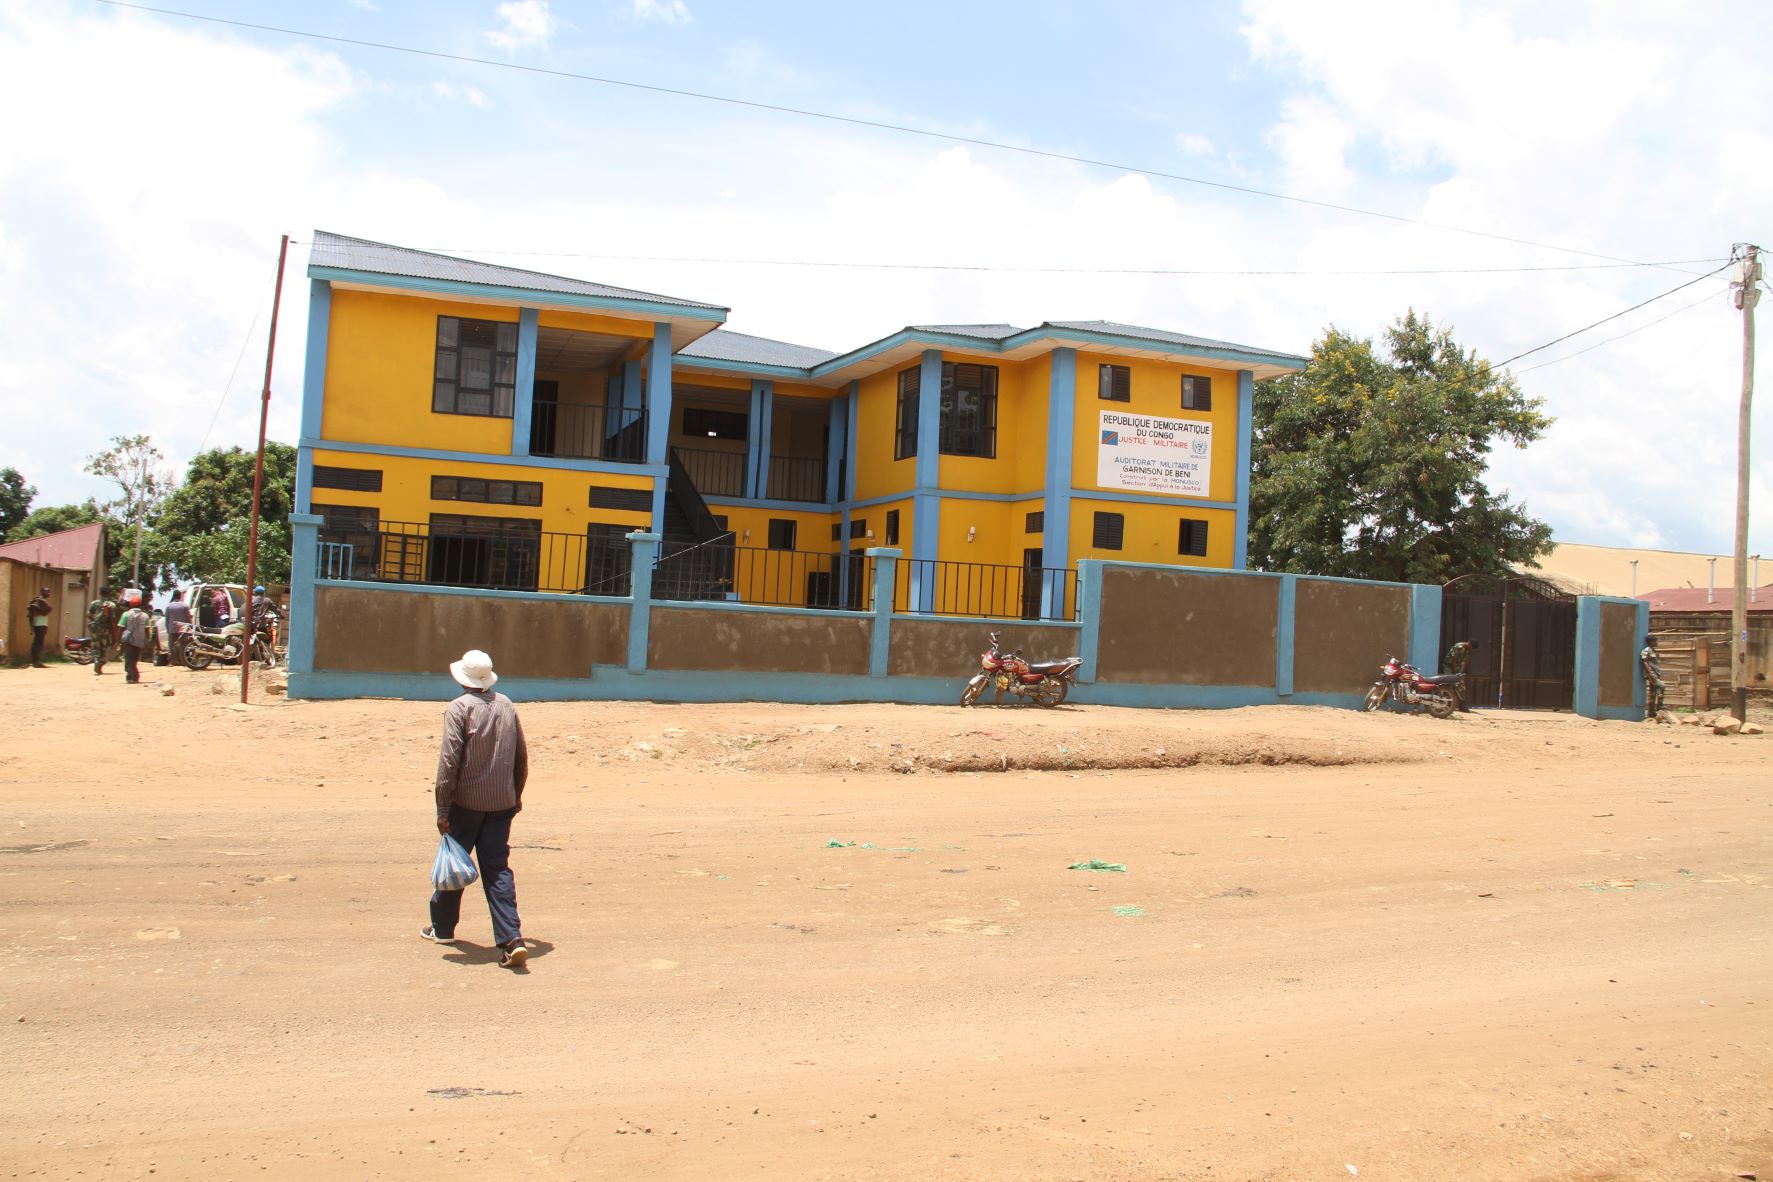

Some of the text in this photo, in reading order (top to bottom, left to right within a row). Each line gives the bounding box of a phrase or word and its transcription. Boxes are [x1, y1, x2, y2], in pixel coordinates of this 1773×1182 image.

[1104, 414, 1210, 434] REPUBLIQUE DEMOCRATIQUE
[1136, 428, 1174, 440] DU CONGO
[1119, 436, 1188, 449] JUSTICE MILITAIRE
[1114, 456, 1156, 466] AUDITORAT
[1160, 461, 1190, 470] MILITAIRE
[1122, 466, 1162, 476] GARNISON
[1175, 470, 1190, 478] BENI
